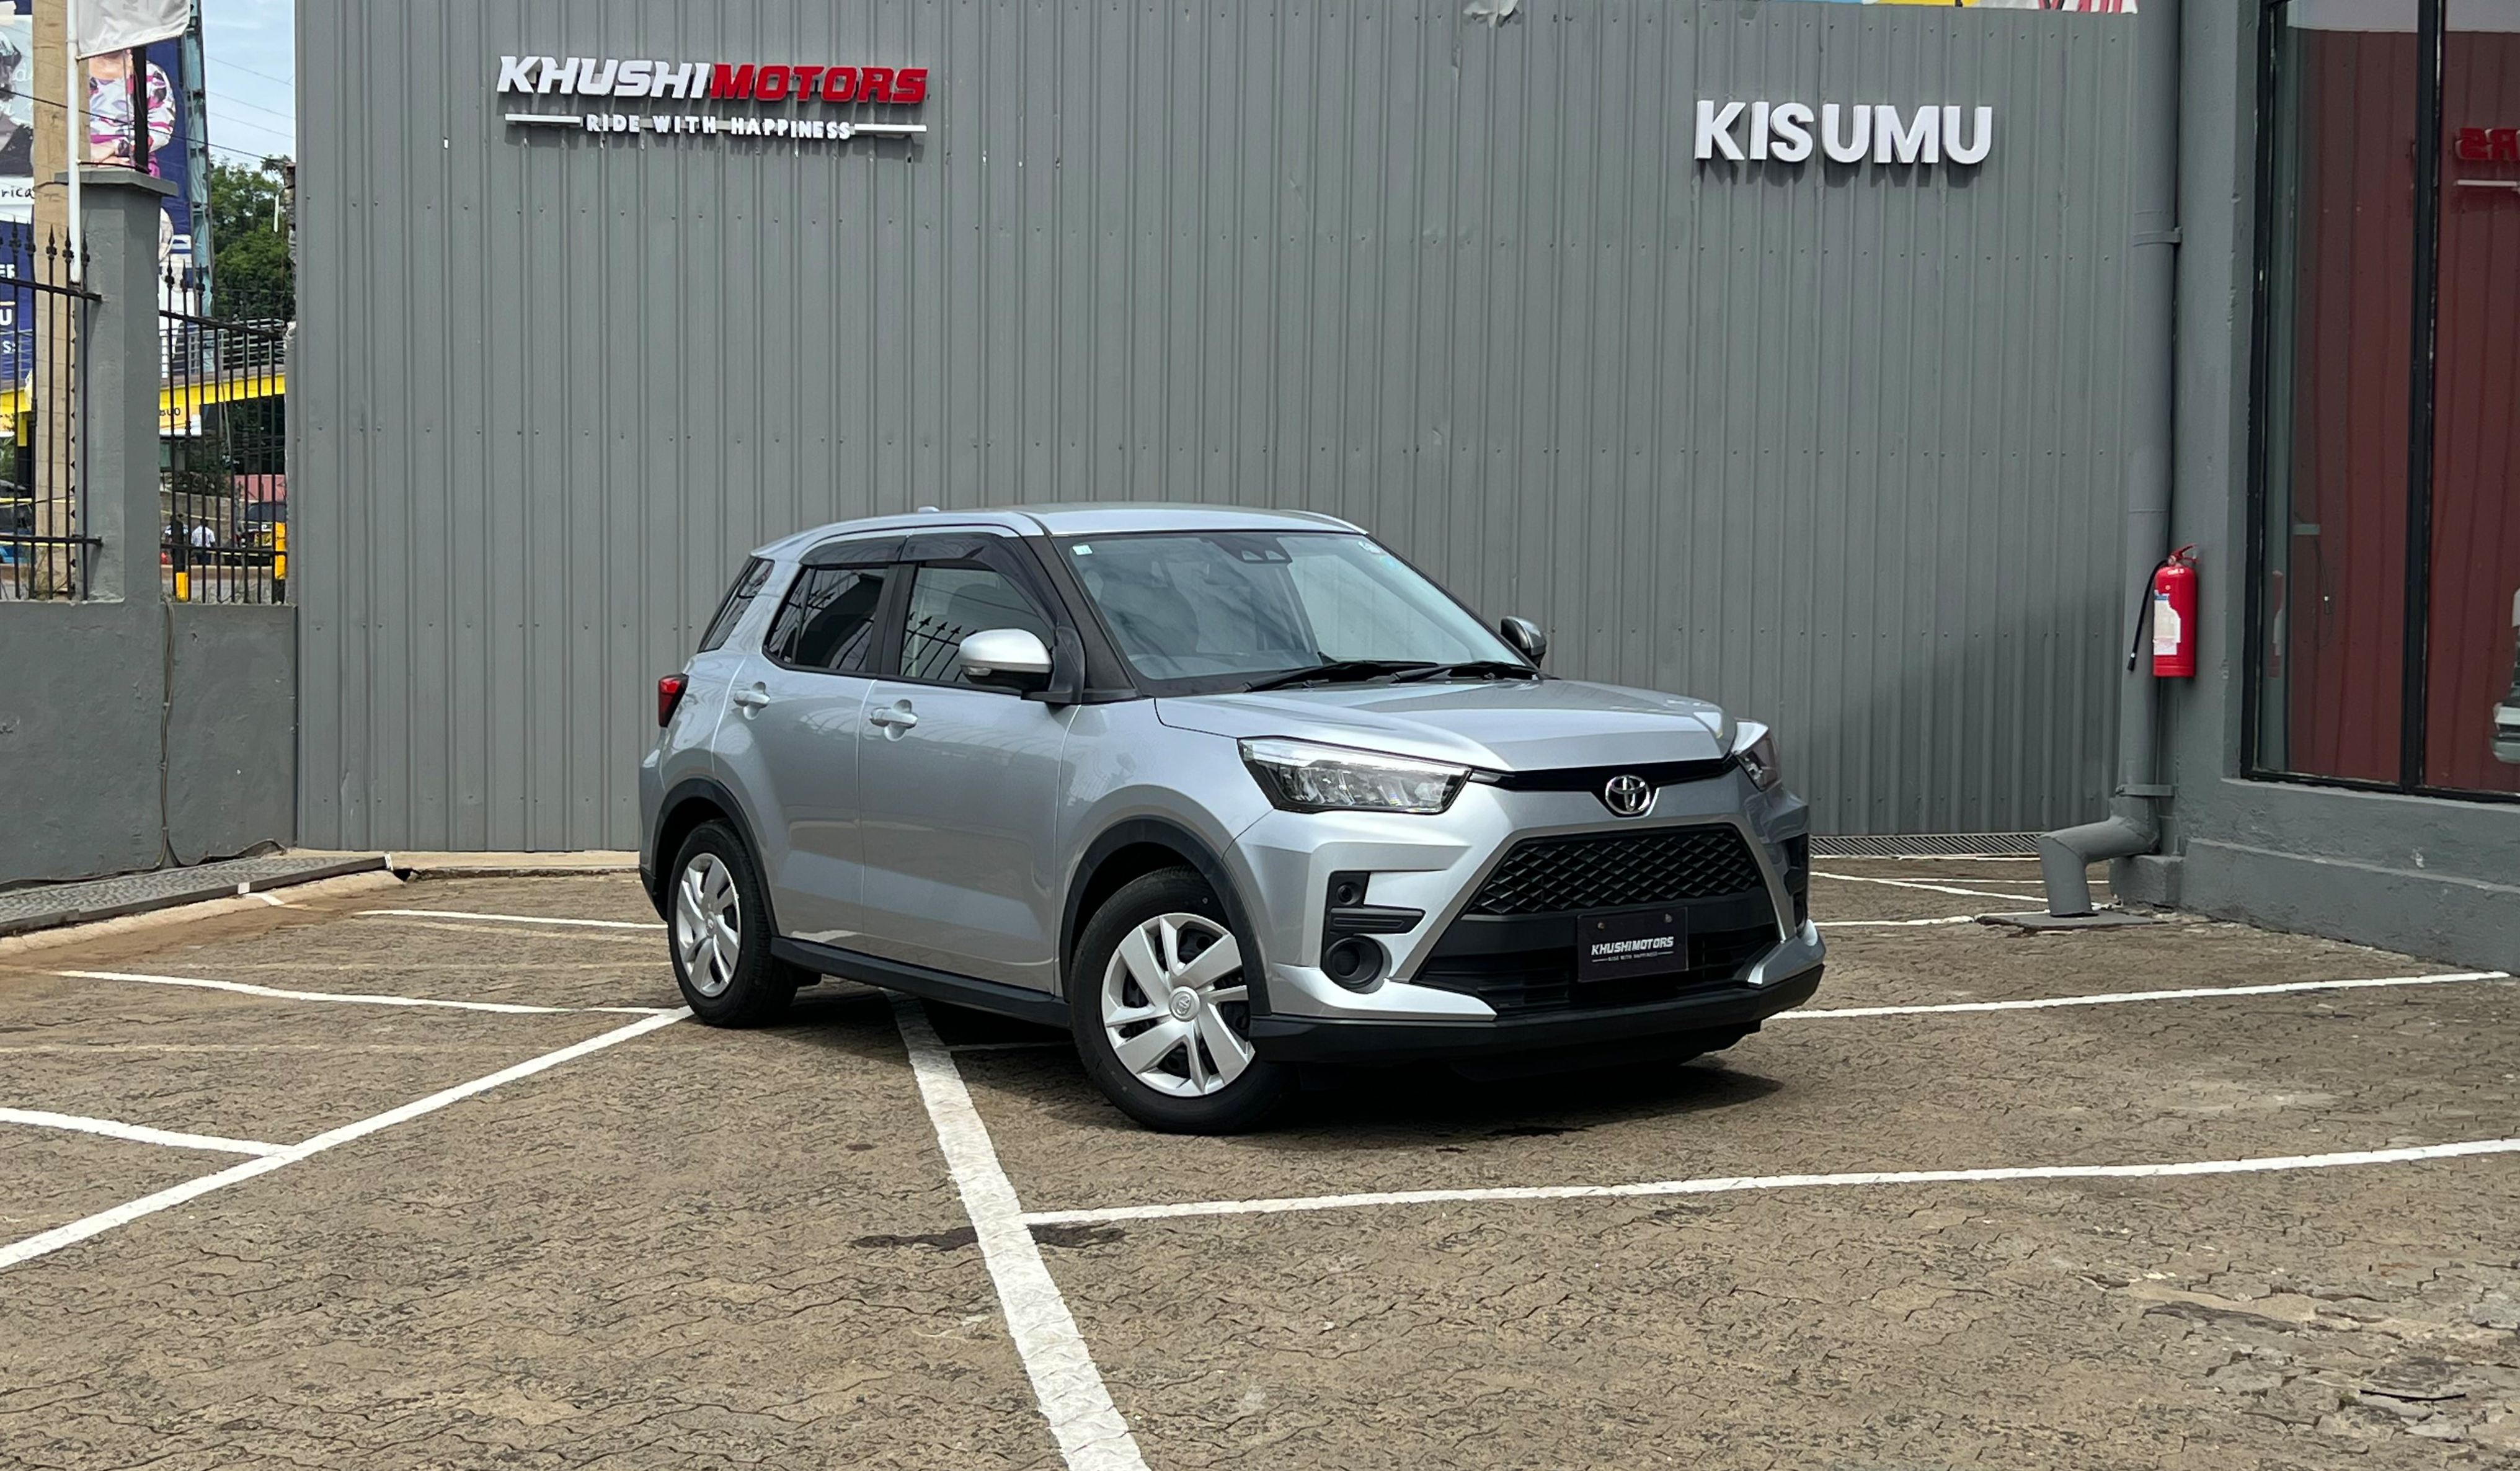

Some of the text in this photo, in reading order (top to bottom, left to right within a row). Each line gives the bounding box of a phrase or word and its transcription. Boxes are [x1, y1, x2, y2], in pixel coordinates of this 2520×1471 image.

[586, 113, 851, 140] RIDE WITH HAPPINESS
[1694, 100, 1992, 164] KISUMU
